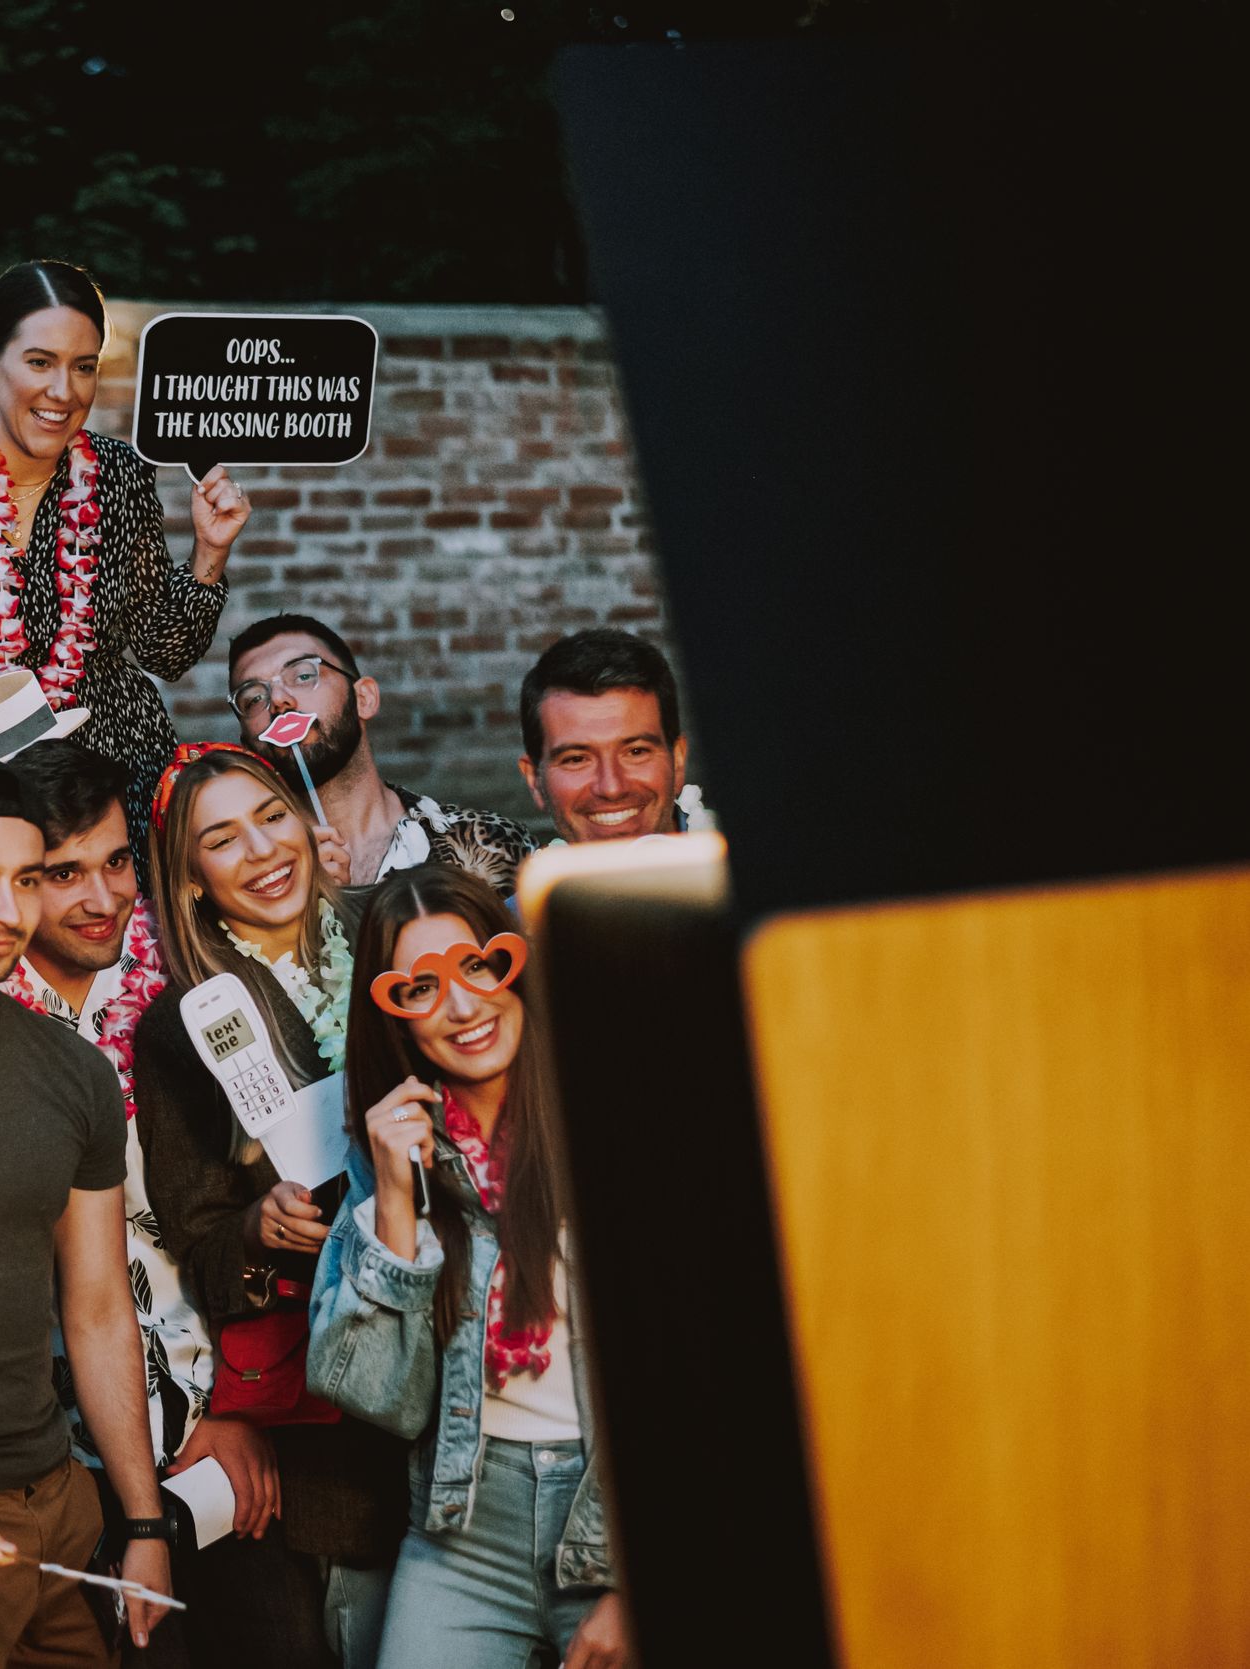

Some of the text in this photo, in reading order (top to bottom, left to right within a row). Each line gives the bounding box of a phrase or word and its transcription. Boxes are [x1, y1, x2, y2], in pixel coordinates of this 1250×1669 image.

[226, 338, 296, 365] OOPS...
[152, 374, 361, 403] I THOUGHT THIS WAS
[154, 411, 352, 439] THE KISSING BOOTH
[205, 1015, 242, 1044] text
[213, 1035, 239, 1057] me
[267, 1075, 275, 1085] 6
[259, 1094, 266, 1103] 8
[272, 1086, 279, 1095] 9
